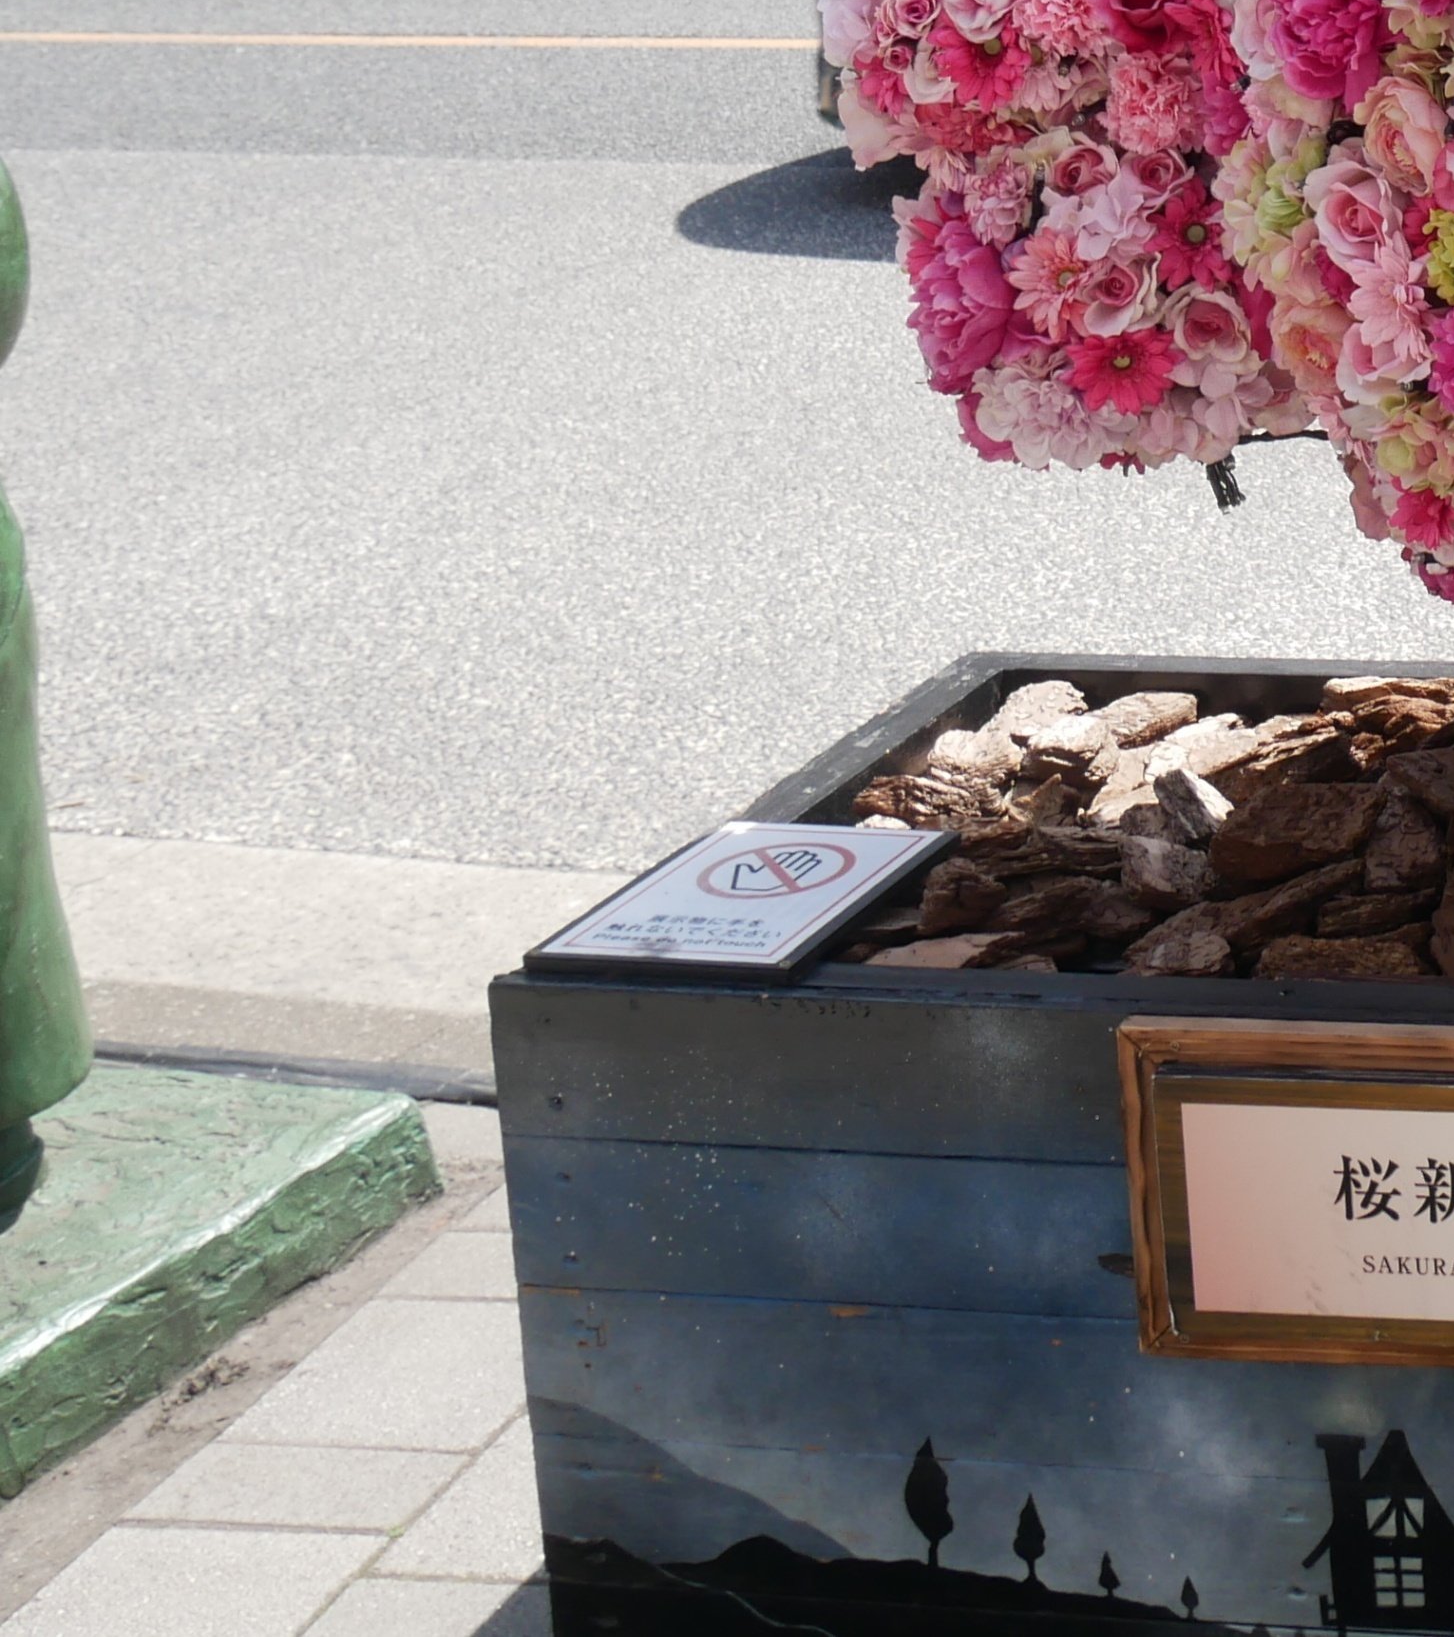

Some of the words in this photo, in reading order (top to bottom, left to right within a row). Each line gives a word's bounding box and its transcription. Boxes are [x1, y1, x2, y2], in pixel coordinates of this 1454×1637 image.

[606, 923, 782, 939] 触れないでください
[592, 933, 651, 942] Please
[716, 938, 767, 949] touch
